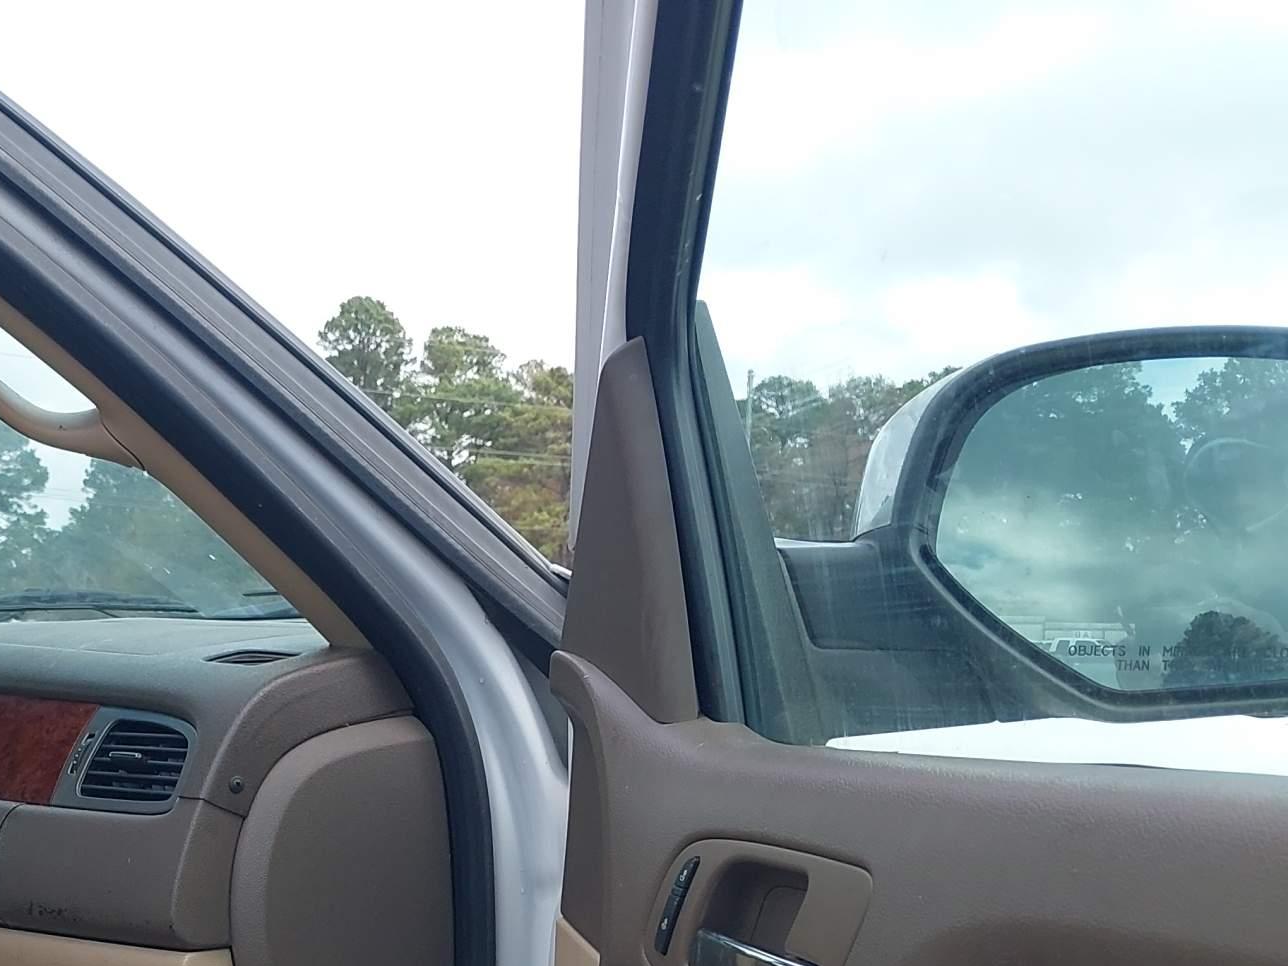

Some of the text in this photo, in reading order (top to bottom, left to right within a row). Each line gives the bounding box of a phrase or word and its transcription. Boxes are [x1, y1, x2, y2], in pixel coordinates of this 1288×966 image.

[1068, 645, 1127, 657] OBJECTS
[1138, 646, 1151, 657] IN
[1117, 660, 1150, 671] THAN
